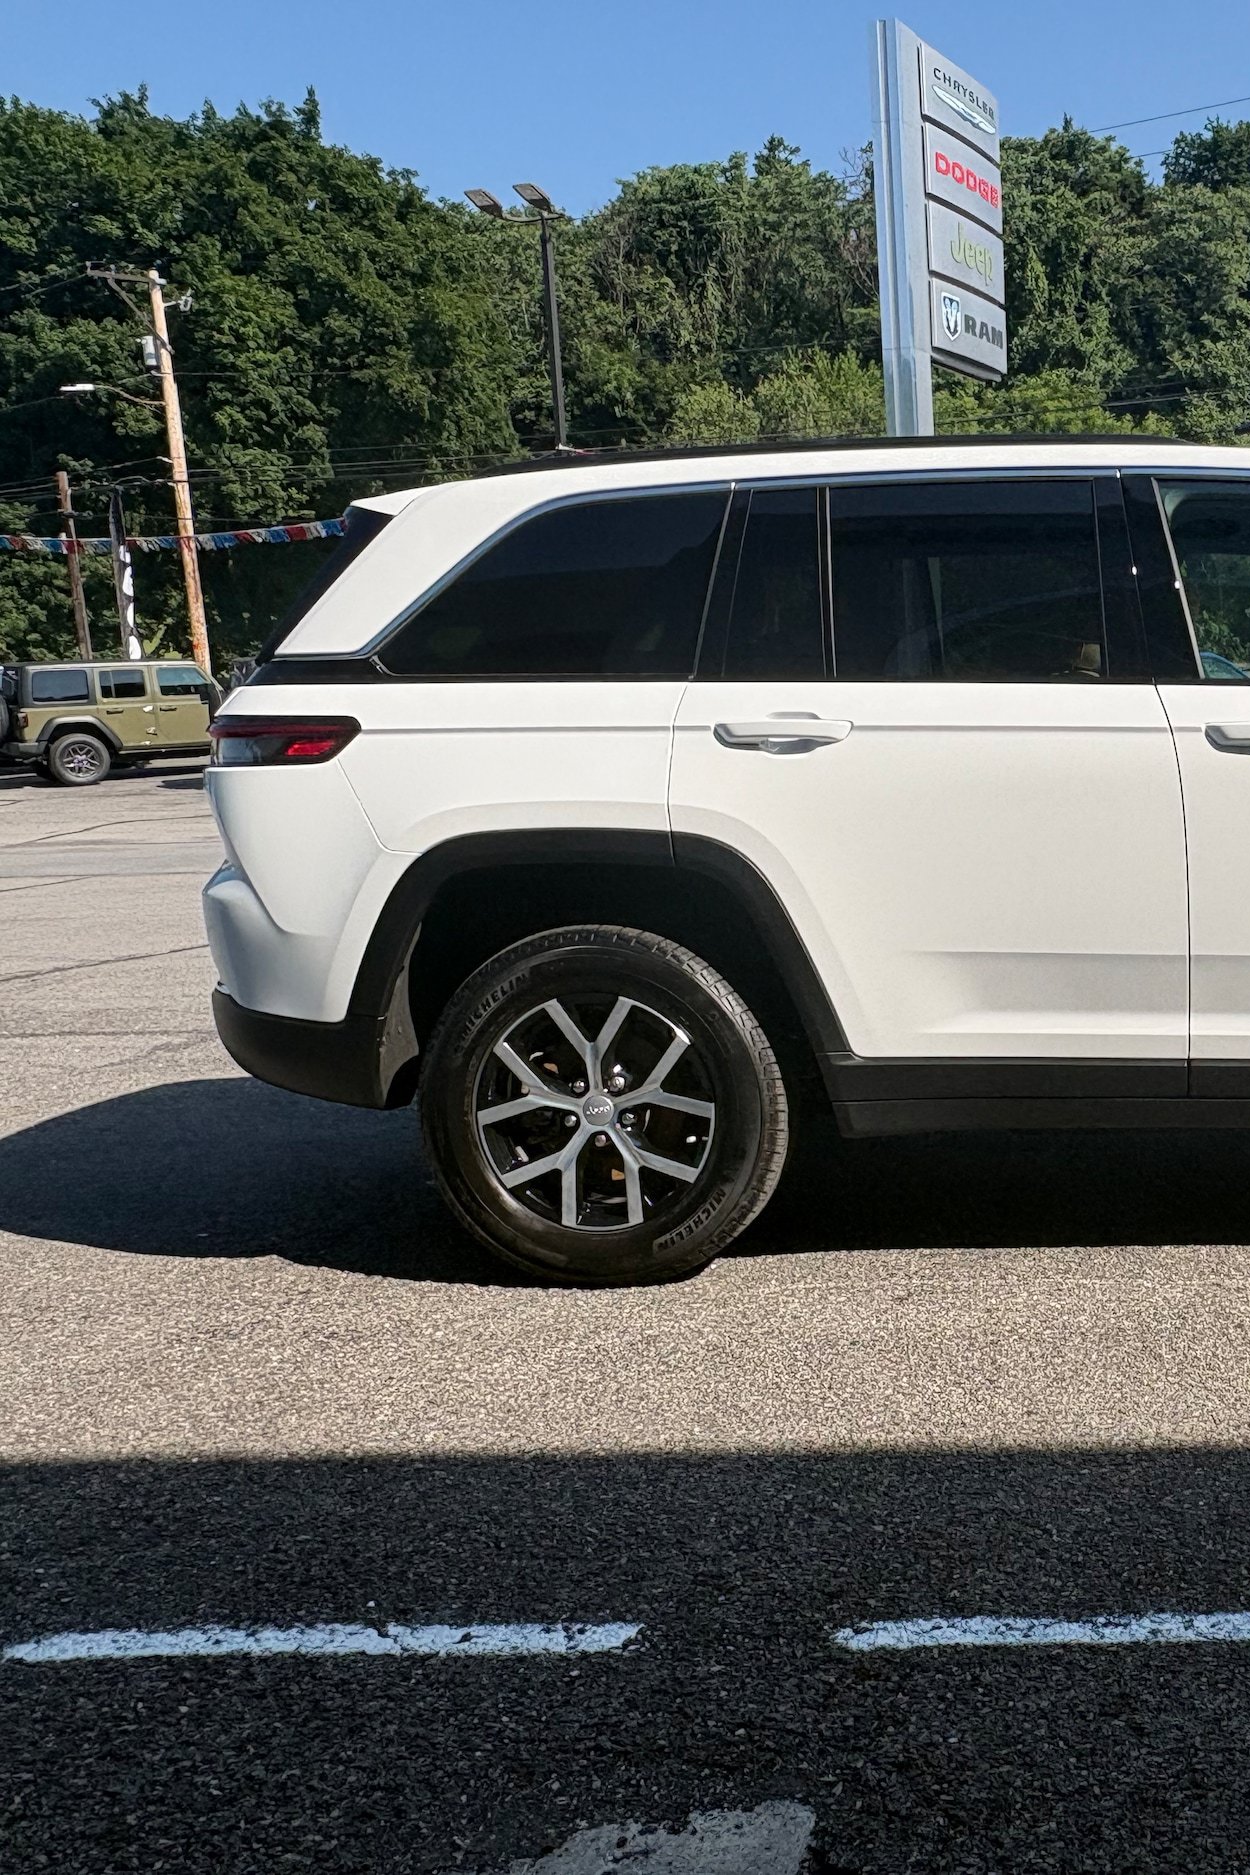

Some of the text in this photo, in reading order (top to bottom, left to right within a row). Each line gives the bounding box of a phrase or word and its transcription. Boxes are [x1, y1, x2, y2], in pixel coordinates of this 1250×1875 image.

[933, 67, 995, 120] CHRYSLER
[935, 151, 999, 208] DODGE
[950, 221, 993, 286] Jeep
[964, 313, 1003, 349] RAM
[655, 1187, 727, 1250] MICHELIN
